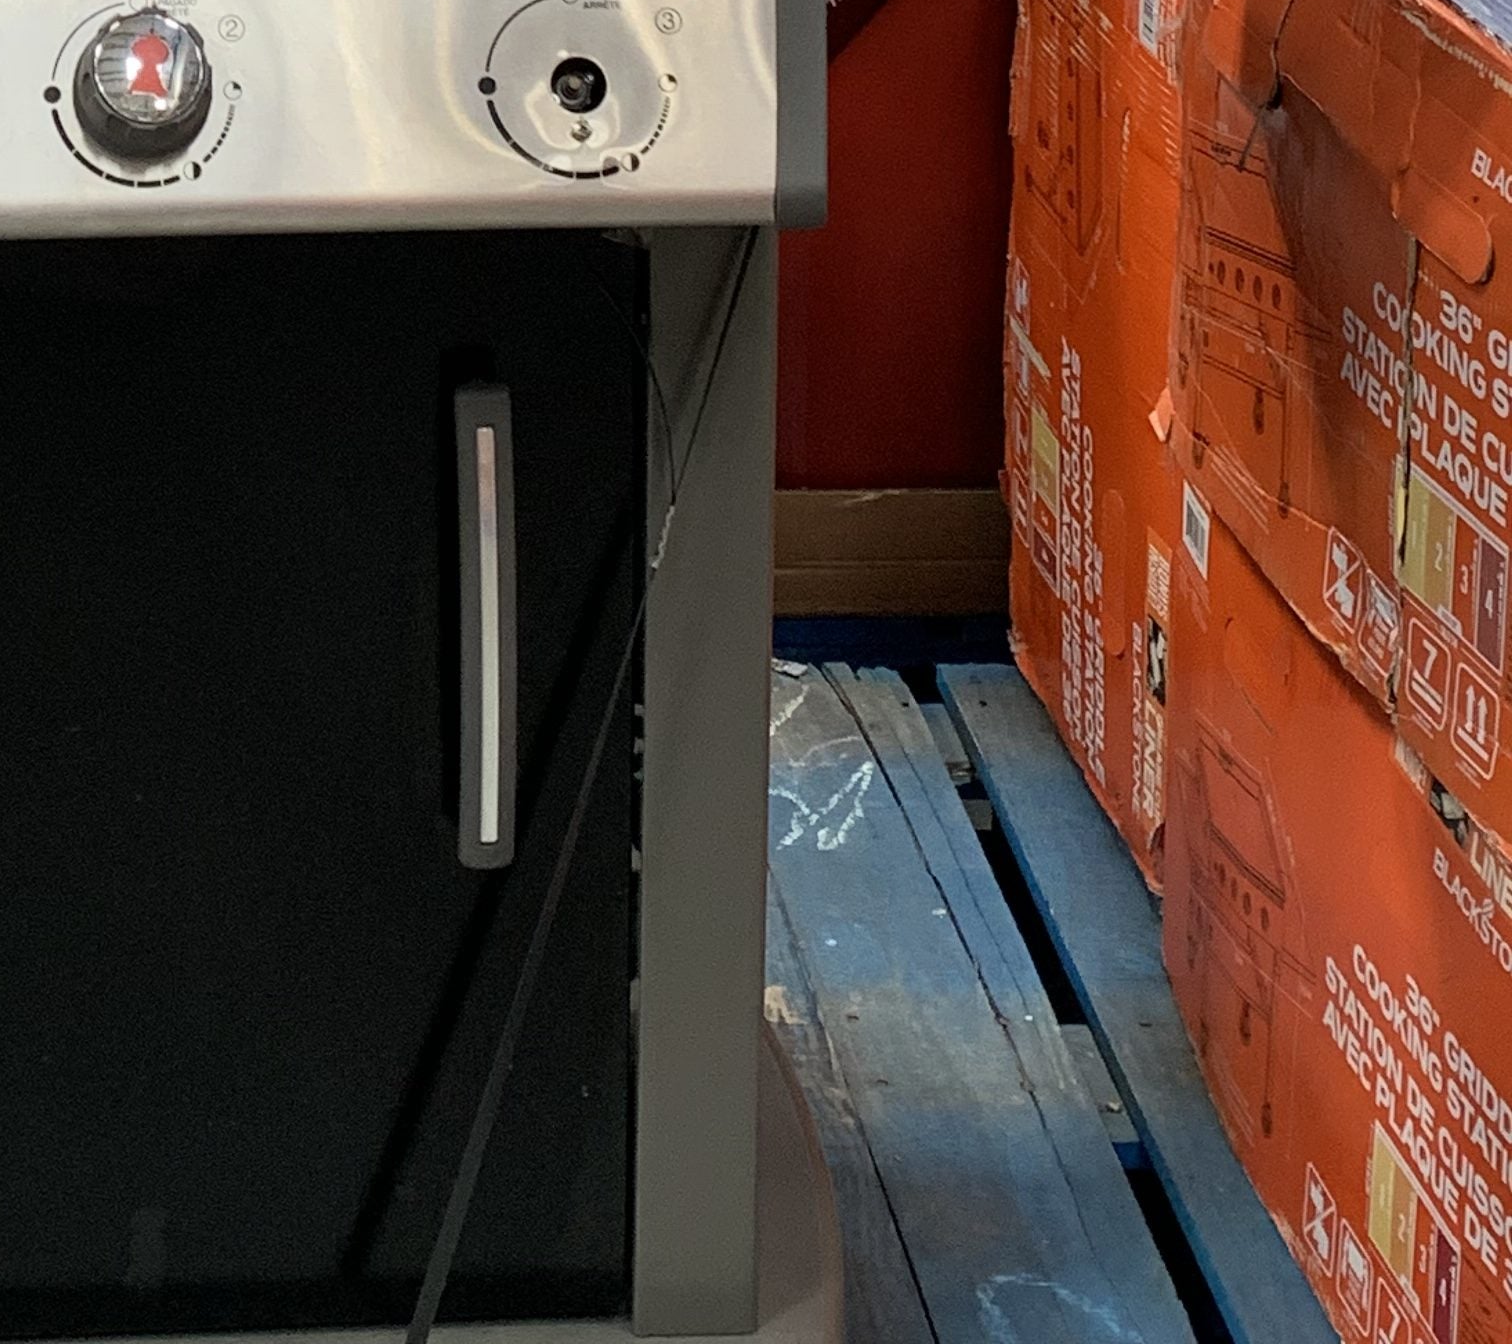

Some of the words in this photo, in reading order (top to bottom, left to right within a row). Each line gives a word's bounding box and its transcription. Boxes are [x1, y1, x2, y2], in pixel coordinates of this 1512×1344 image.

[1340, 351, 1392, 429] AVEC
[1444, 394, 1477, 445] DE
[1433, 847, 1512, 975] BLACKSTO
[1326, 956, 1403, 1096] STATION
[1407, 1081, 1436, 1140] DE
[1353, 944, 1443, 1093] COOKING
[1323, 1001, 1372, 1091] AVEC
[1375, 1080, 1460, 1223] PLAQUE
[1464, 1209, 1497, 1276] DE
